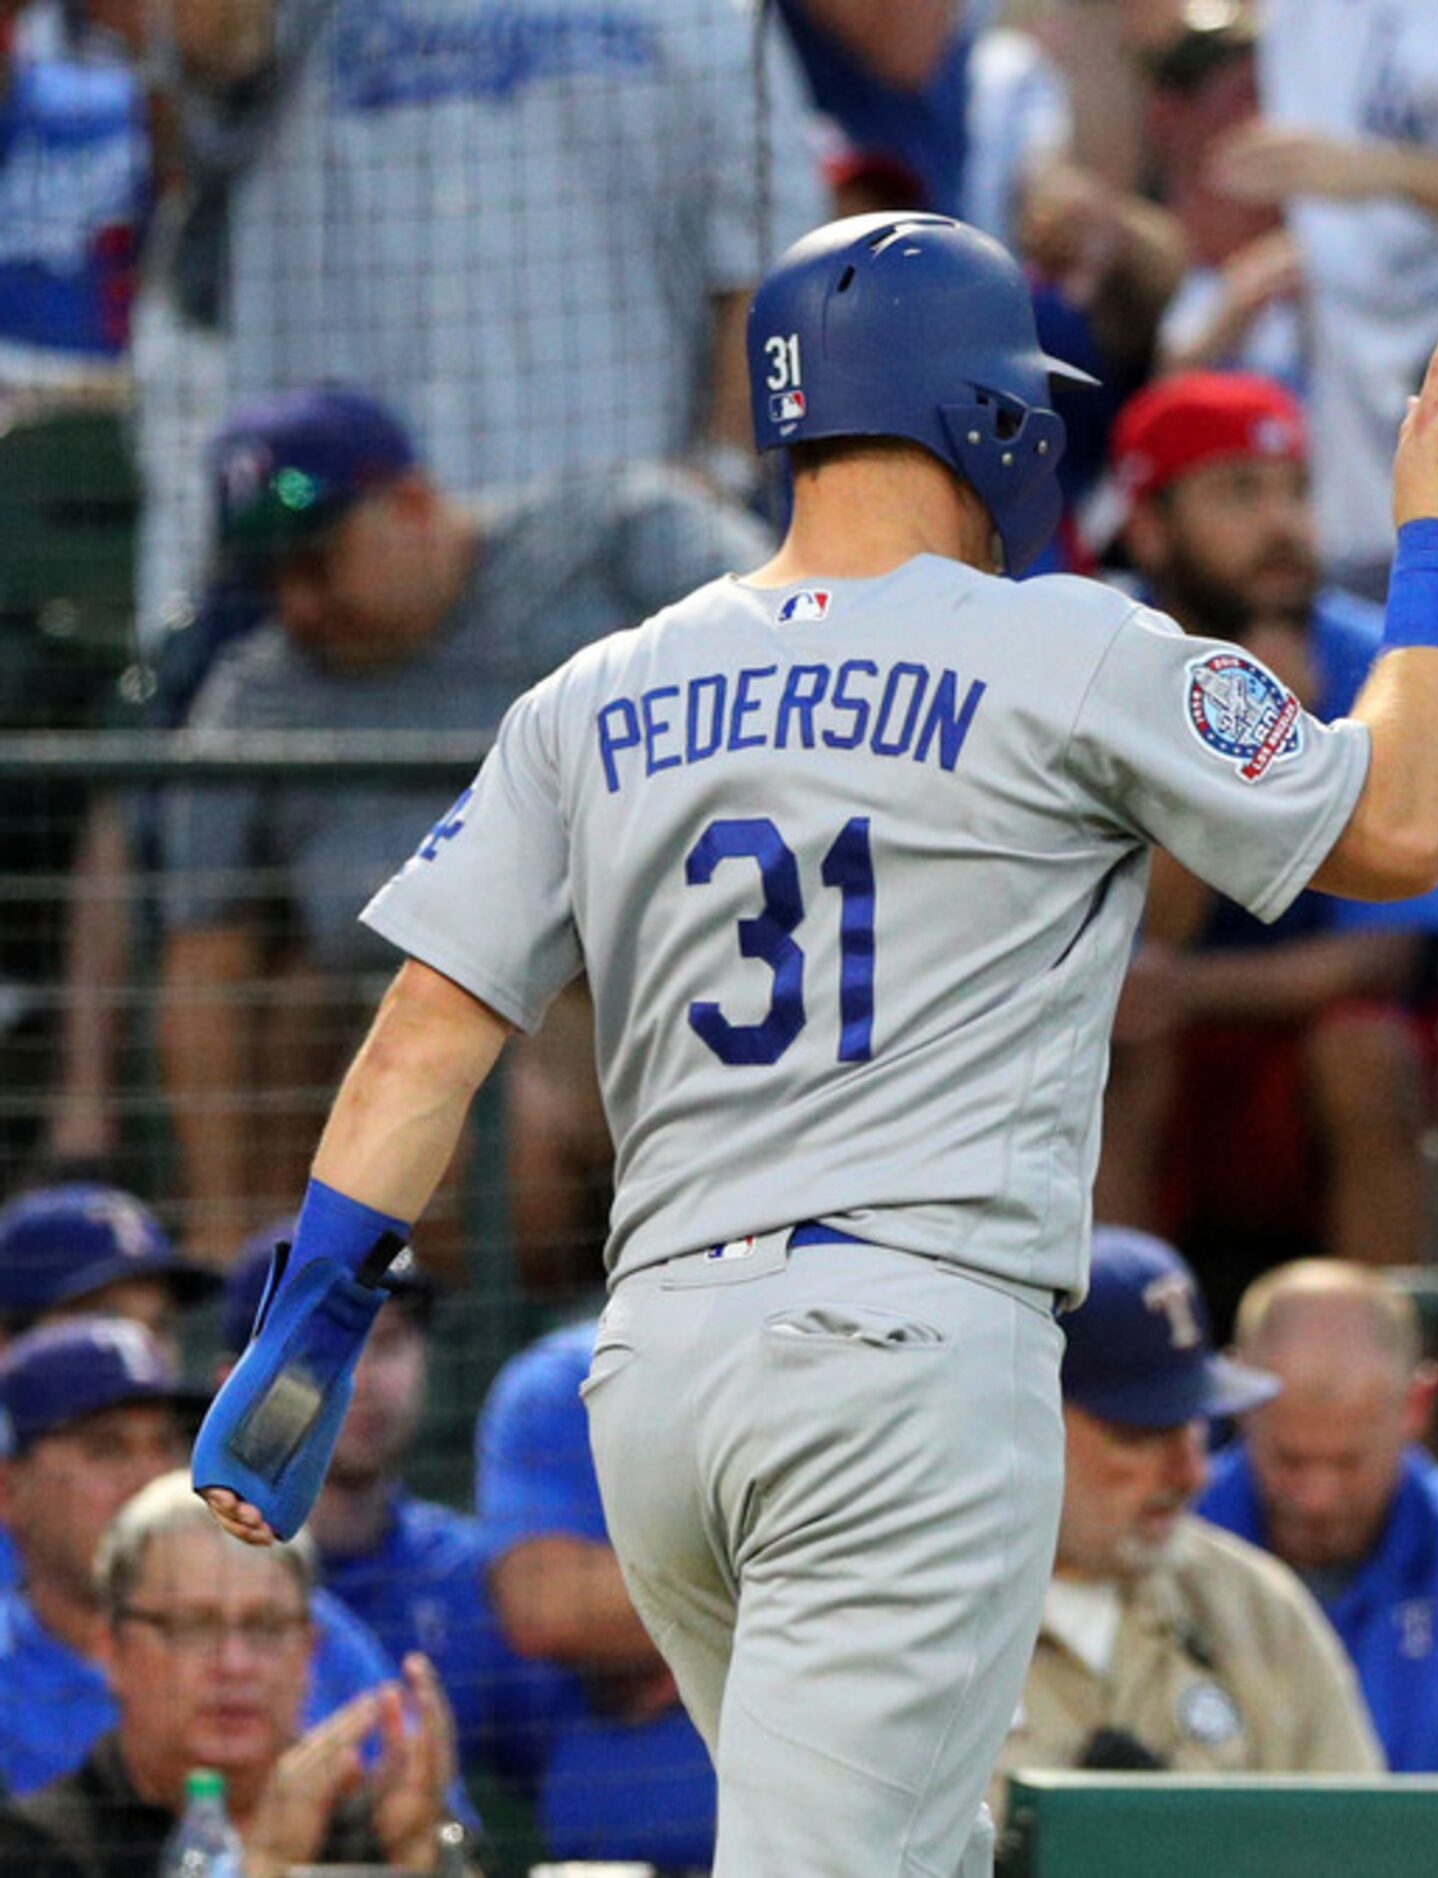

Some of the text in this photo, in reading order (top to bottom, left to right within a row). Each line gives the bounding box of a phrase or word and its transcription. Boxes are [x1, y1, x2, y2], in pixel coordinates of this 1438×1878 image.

[765, 333, 801, 391] 31
[598, 660, 988, 793] PEDERSON
[685, 817, 876, 1066] 31
